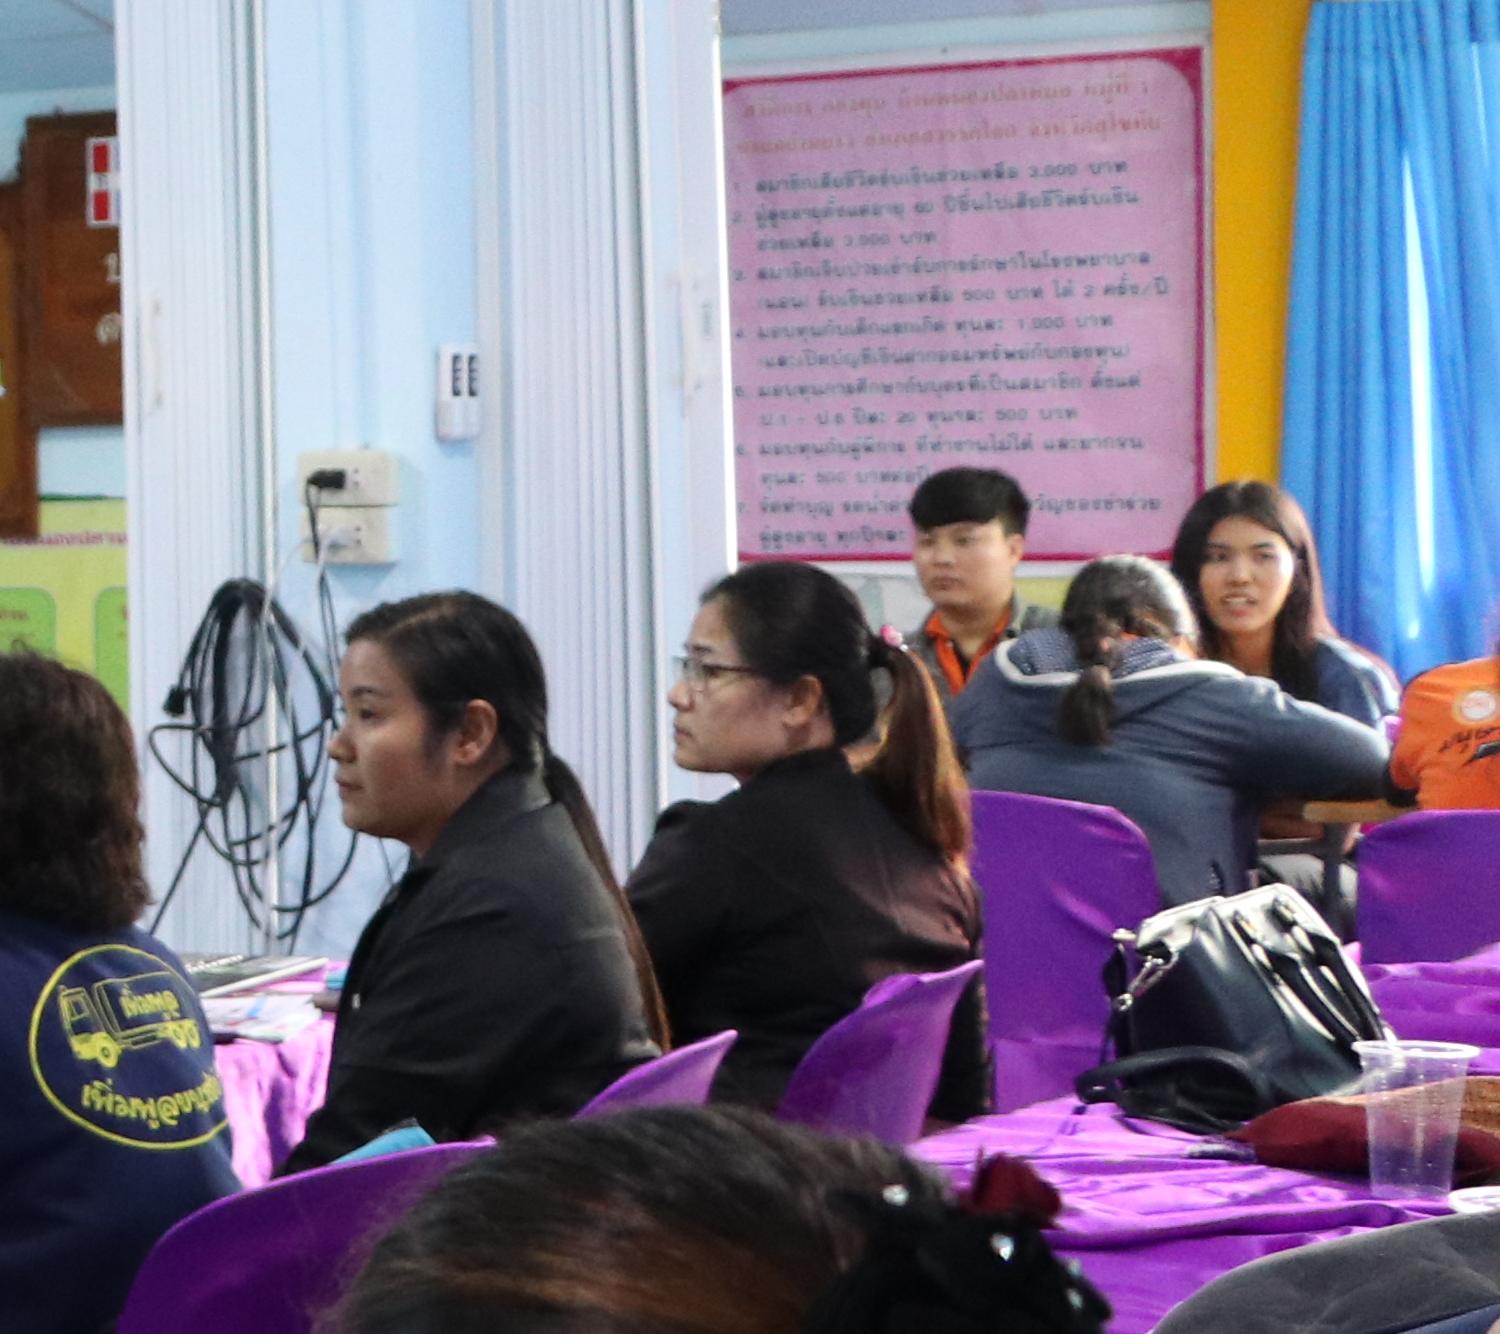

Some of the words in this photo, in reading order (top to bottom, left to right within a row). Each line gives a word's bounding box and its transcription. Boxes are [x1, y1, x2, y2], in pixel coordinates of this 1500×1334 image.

[1087, 160, 1128, 175] บาท
[900, 230, 937, 246] บาท
[1006, 285, 1044, 300] บาท
[1075, 314, 1113, 328] บาท
[1039, 407, 1079, 420] บาท
